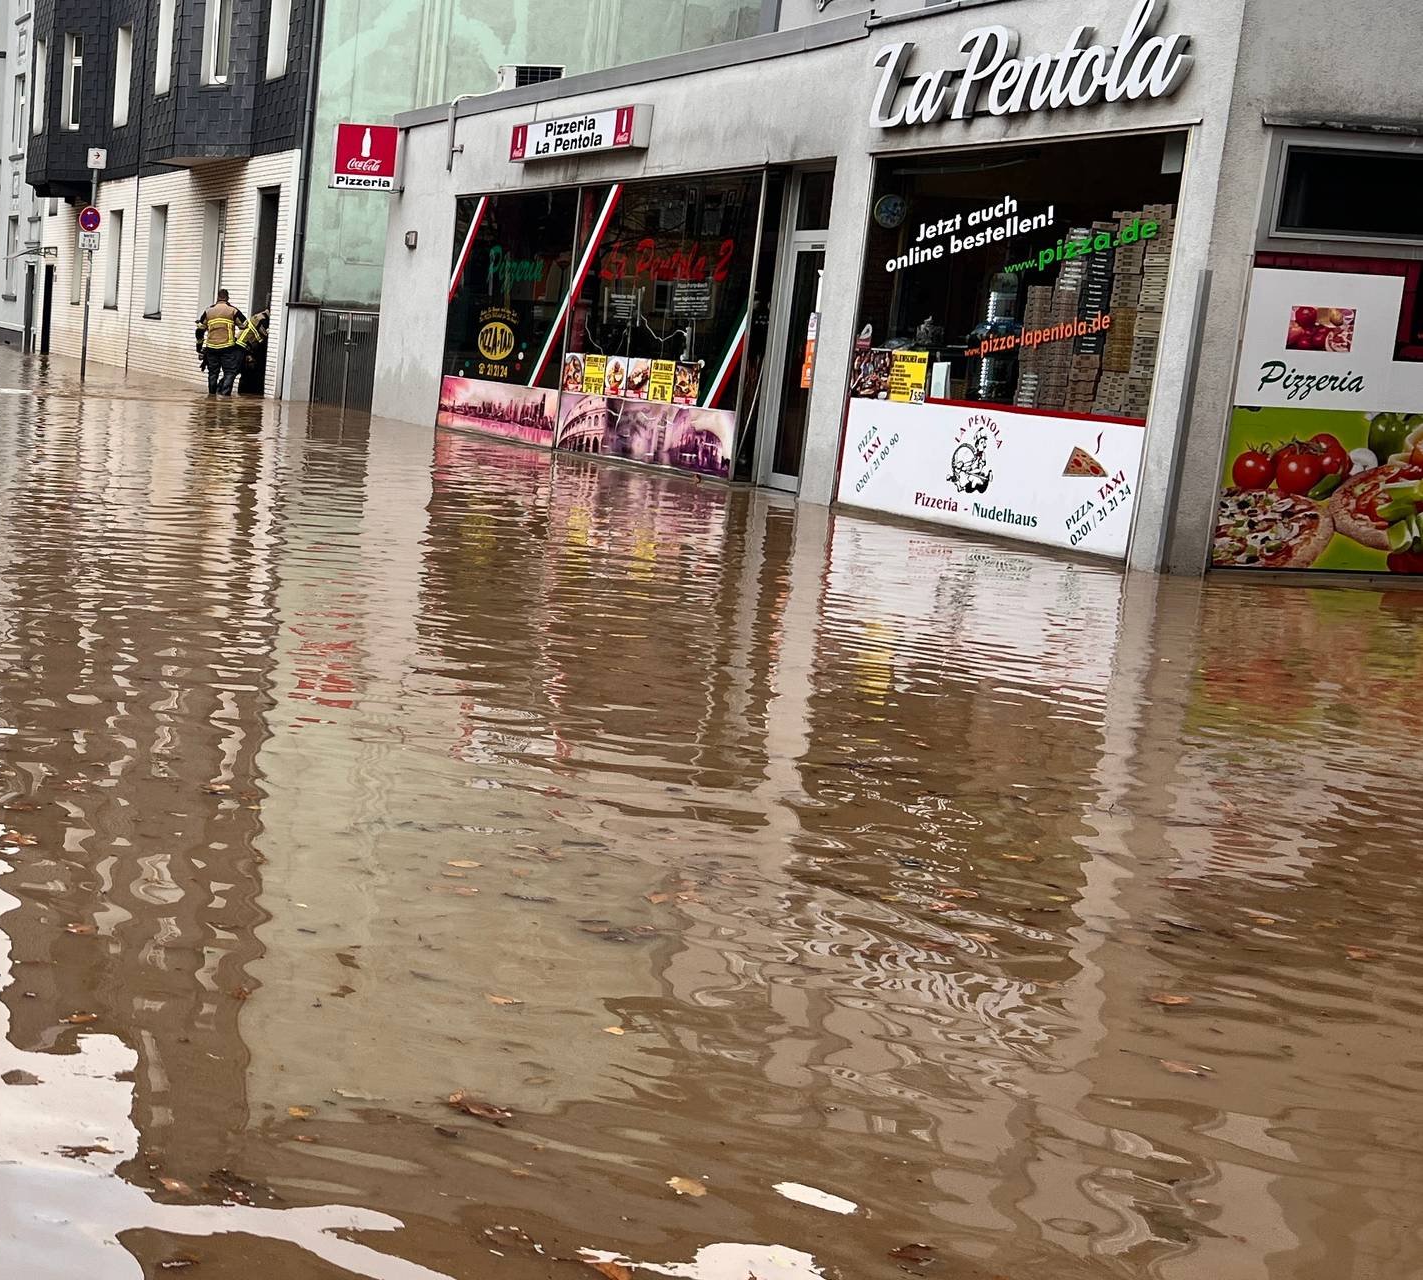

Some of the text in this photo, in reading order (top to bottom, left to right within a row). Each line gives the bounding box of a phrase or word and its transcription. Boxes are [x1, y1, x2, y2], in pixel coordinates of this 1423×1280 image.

[869, 0, 1195, 128] La Pentola
[535, 132, 603, 155] La Pentola
[545, 116, 596, 137] Pizzeria
[336, 176, 391, 188] Pizzeria
[885, 205, 1055, 273] online bestellen!
[916, 195, 1018, 242] Jetzt auch
[713, 239, 735, 282] 2
[1004, 218, 1158, 274] www.pizza.de
[963, 310, 1111, 357] www.pizza-lapentola.de
[1257, 360, 1365, 401] Pizzeria
[857, 425, 878, 453] PIZZA
[862, 436, 882, 463] TAXI
[955, 415, 1003, 449] LA PENTOLA
[855, 471, 871, 493] 0201
[873, 458, 881, 471] 21
[880, 445, 890, 461] 00
[889, 432, 899, 448] 90
[914, 492, 959, 512] Pizzeria
[972, 502, 1038, 528] Nudelhaus
[1065, 470, 1126, 530] PIZZA TAXI
[1070, 521, 1092, 546] 0201
[1097, 506, 1108, 522] 21
[1107, 495, 1118, 512] 21
[1118, 483, 1132, 502] 24
